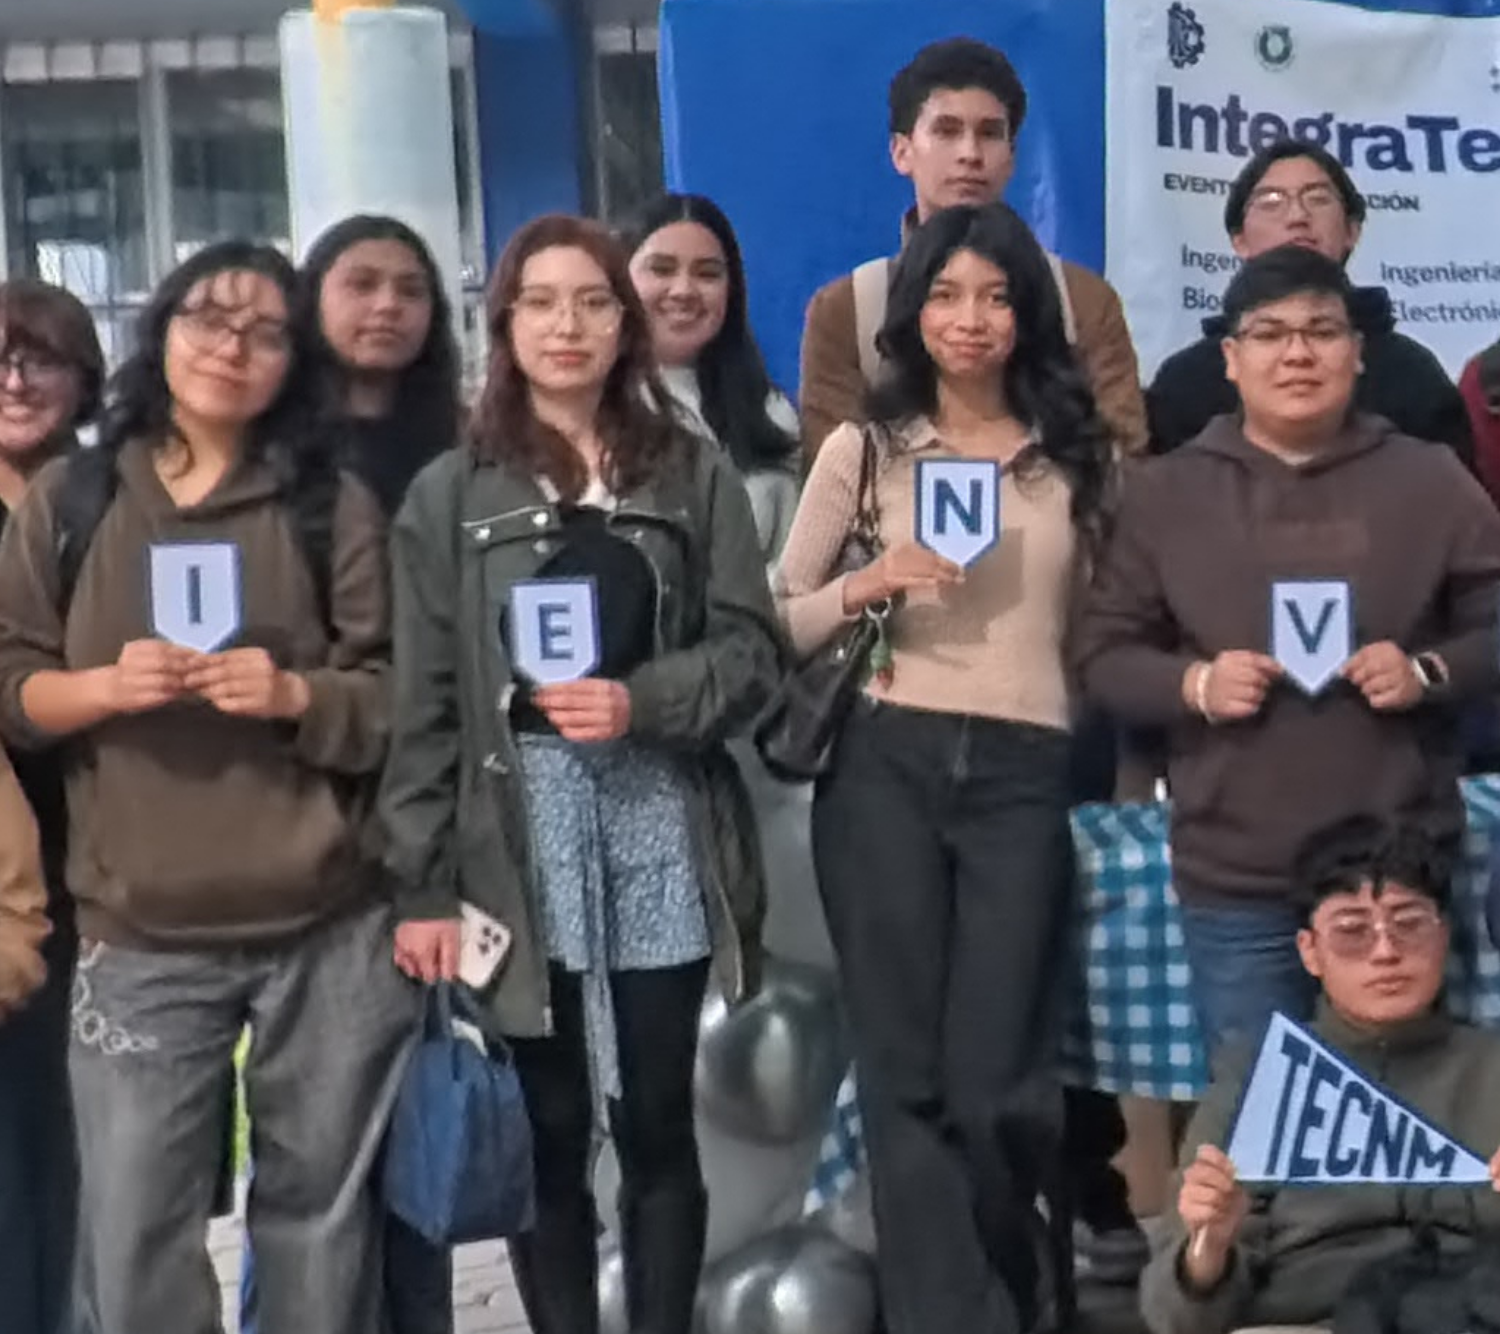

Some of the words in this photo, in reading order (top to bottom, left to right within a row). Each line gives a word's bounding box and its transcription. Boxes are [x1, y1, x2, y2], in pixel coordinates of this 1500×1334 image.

[1164, 173, 1233, 195] EVENT
[933, 478, 982, 536] N
[187, 566, 201, 624] I
[538, 603, 574, 661] E
[1284, 600, 1338, 654] V
[1264, 1031, 1457, 1179] TECNM
